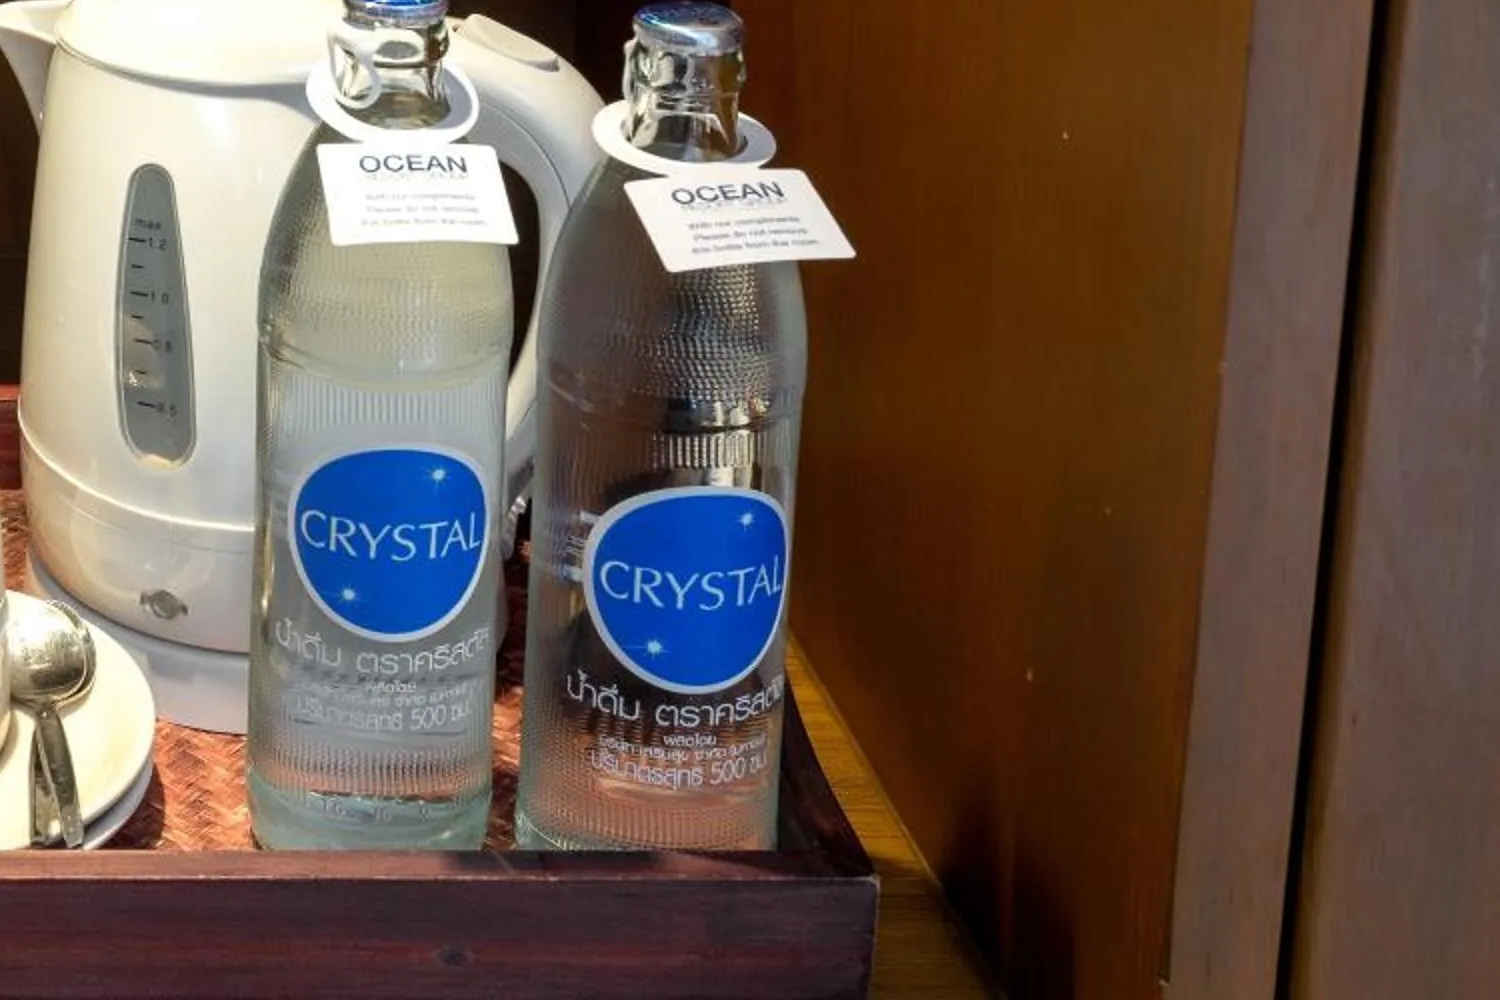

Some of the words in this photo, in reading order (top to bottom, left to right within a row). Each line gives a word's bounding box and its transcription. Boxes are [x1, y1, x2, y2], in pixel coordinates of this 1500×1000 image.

[358, 154, 468, 173] OCEAN
[671, 181, 785, 205] OCEAN
[300, 508, 483, 563] CRYSTAL
[601, 554, 784, 611] CRYSTAL
[410, 704, 447, 731] 500
[709, 757, 746, 785] 500
